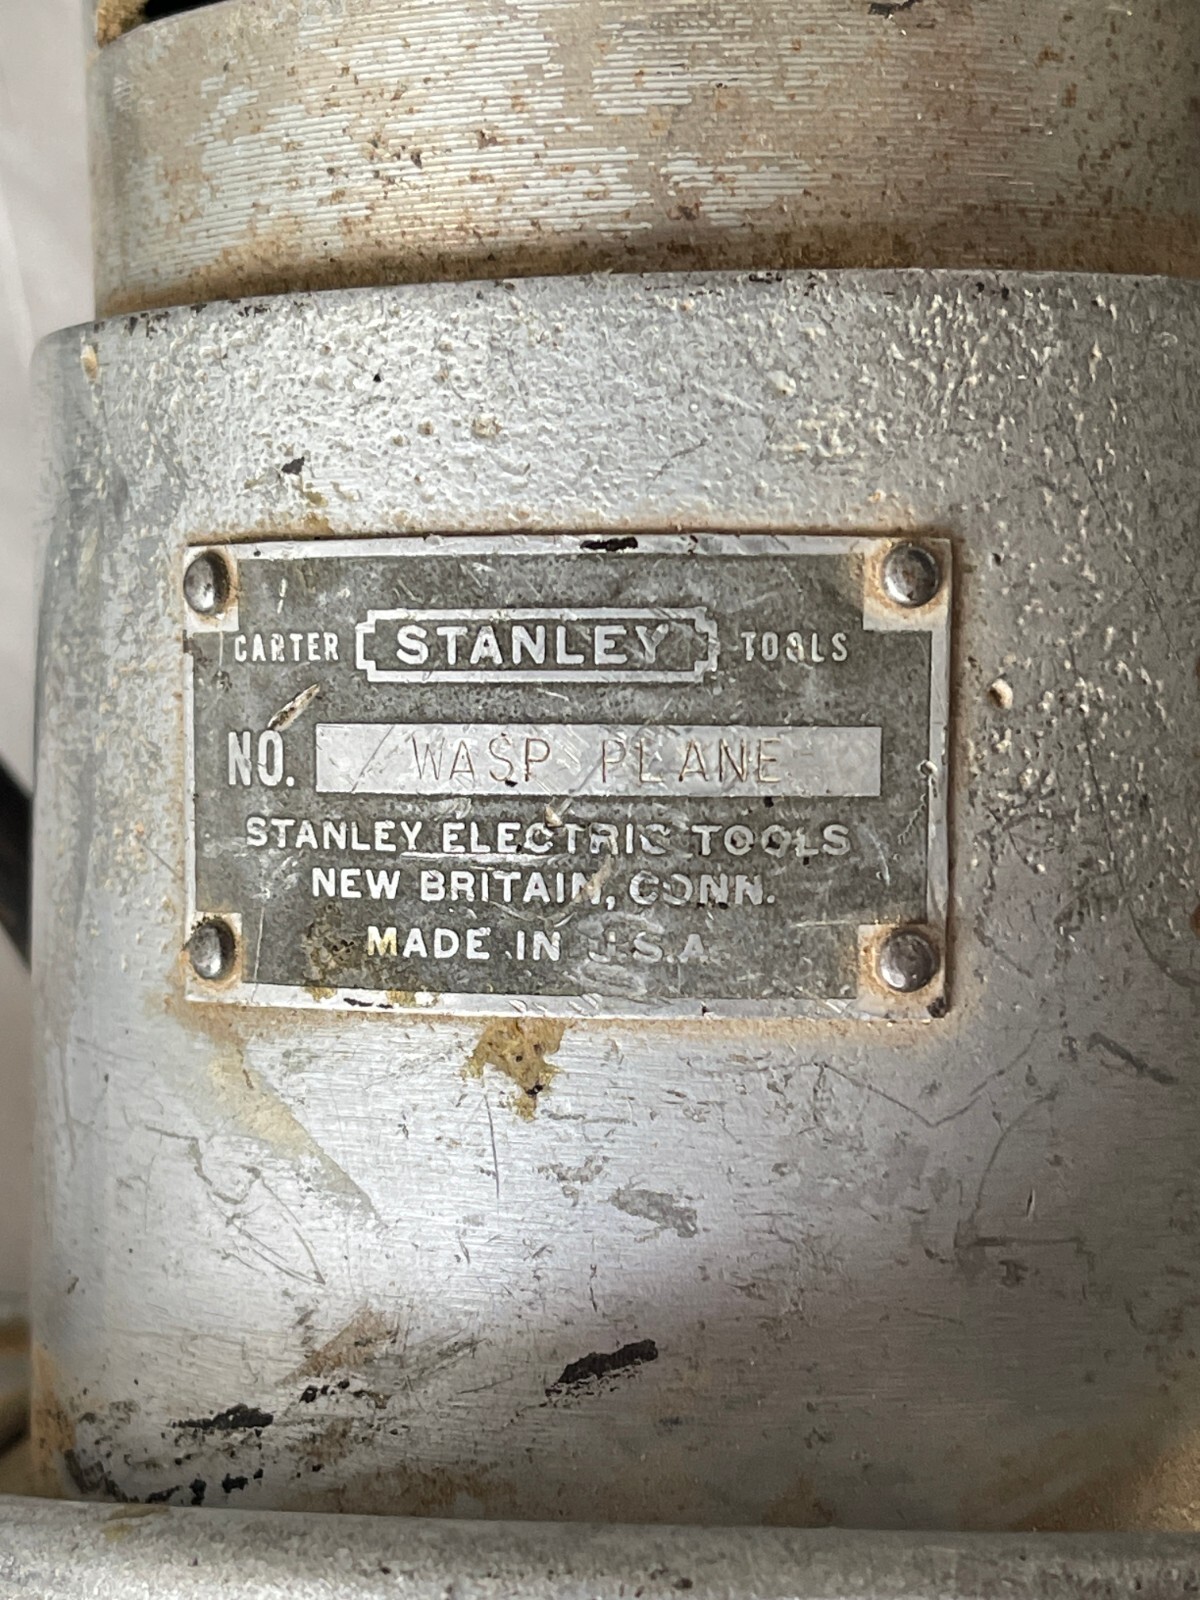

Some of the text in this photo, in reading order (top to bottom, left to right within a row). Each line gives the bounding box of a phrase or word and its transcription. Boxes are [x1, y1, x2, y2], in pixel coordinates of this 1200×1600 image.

[235, 625, 848, 665] CARTER STANLEY TOOLS
[228, 730, 295, 787] NO.
[411, 735, 782, 785] WASP PLANE
[246, 817, 850, 857] STANLEY ELECTRIC TOOLS
[311, 867, 776, 911] NEW BRITAIN, CONN.
[367, 926, 491, 960] MADE
[516, 930, 561, 962] IN
